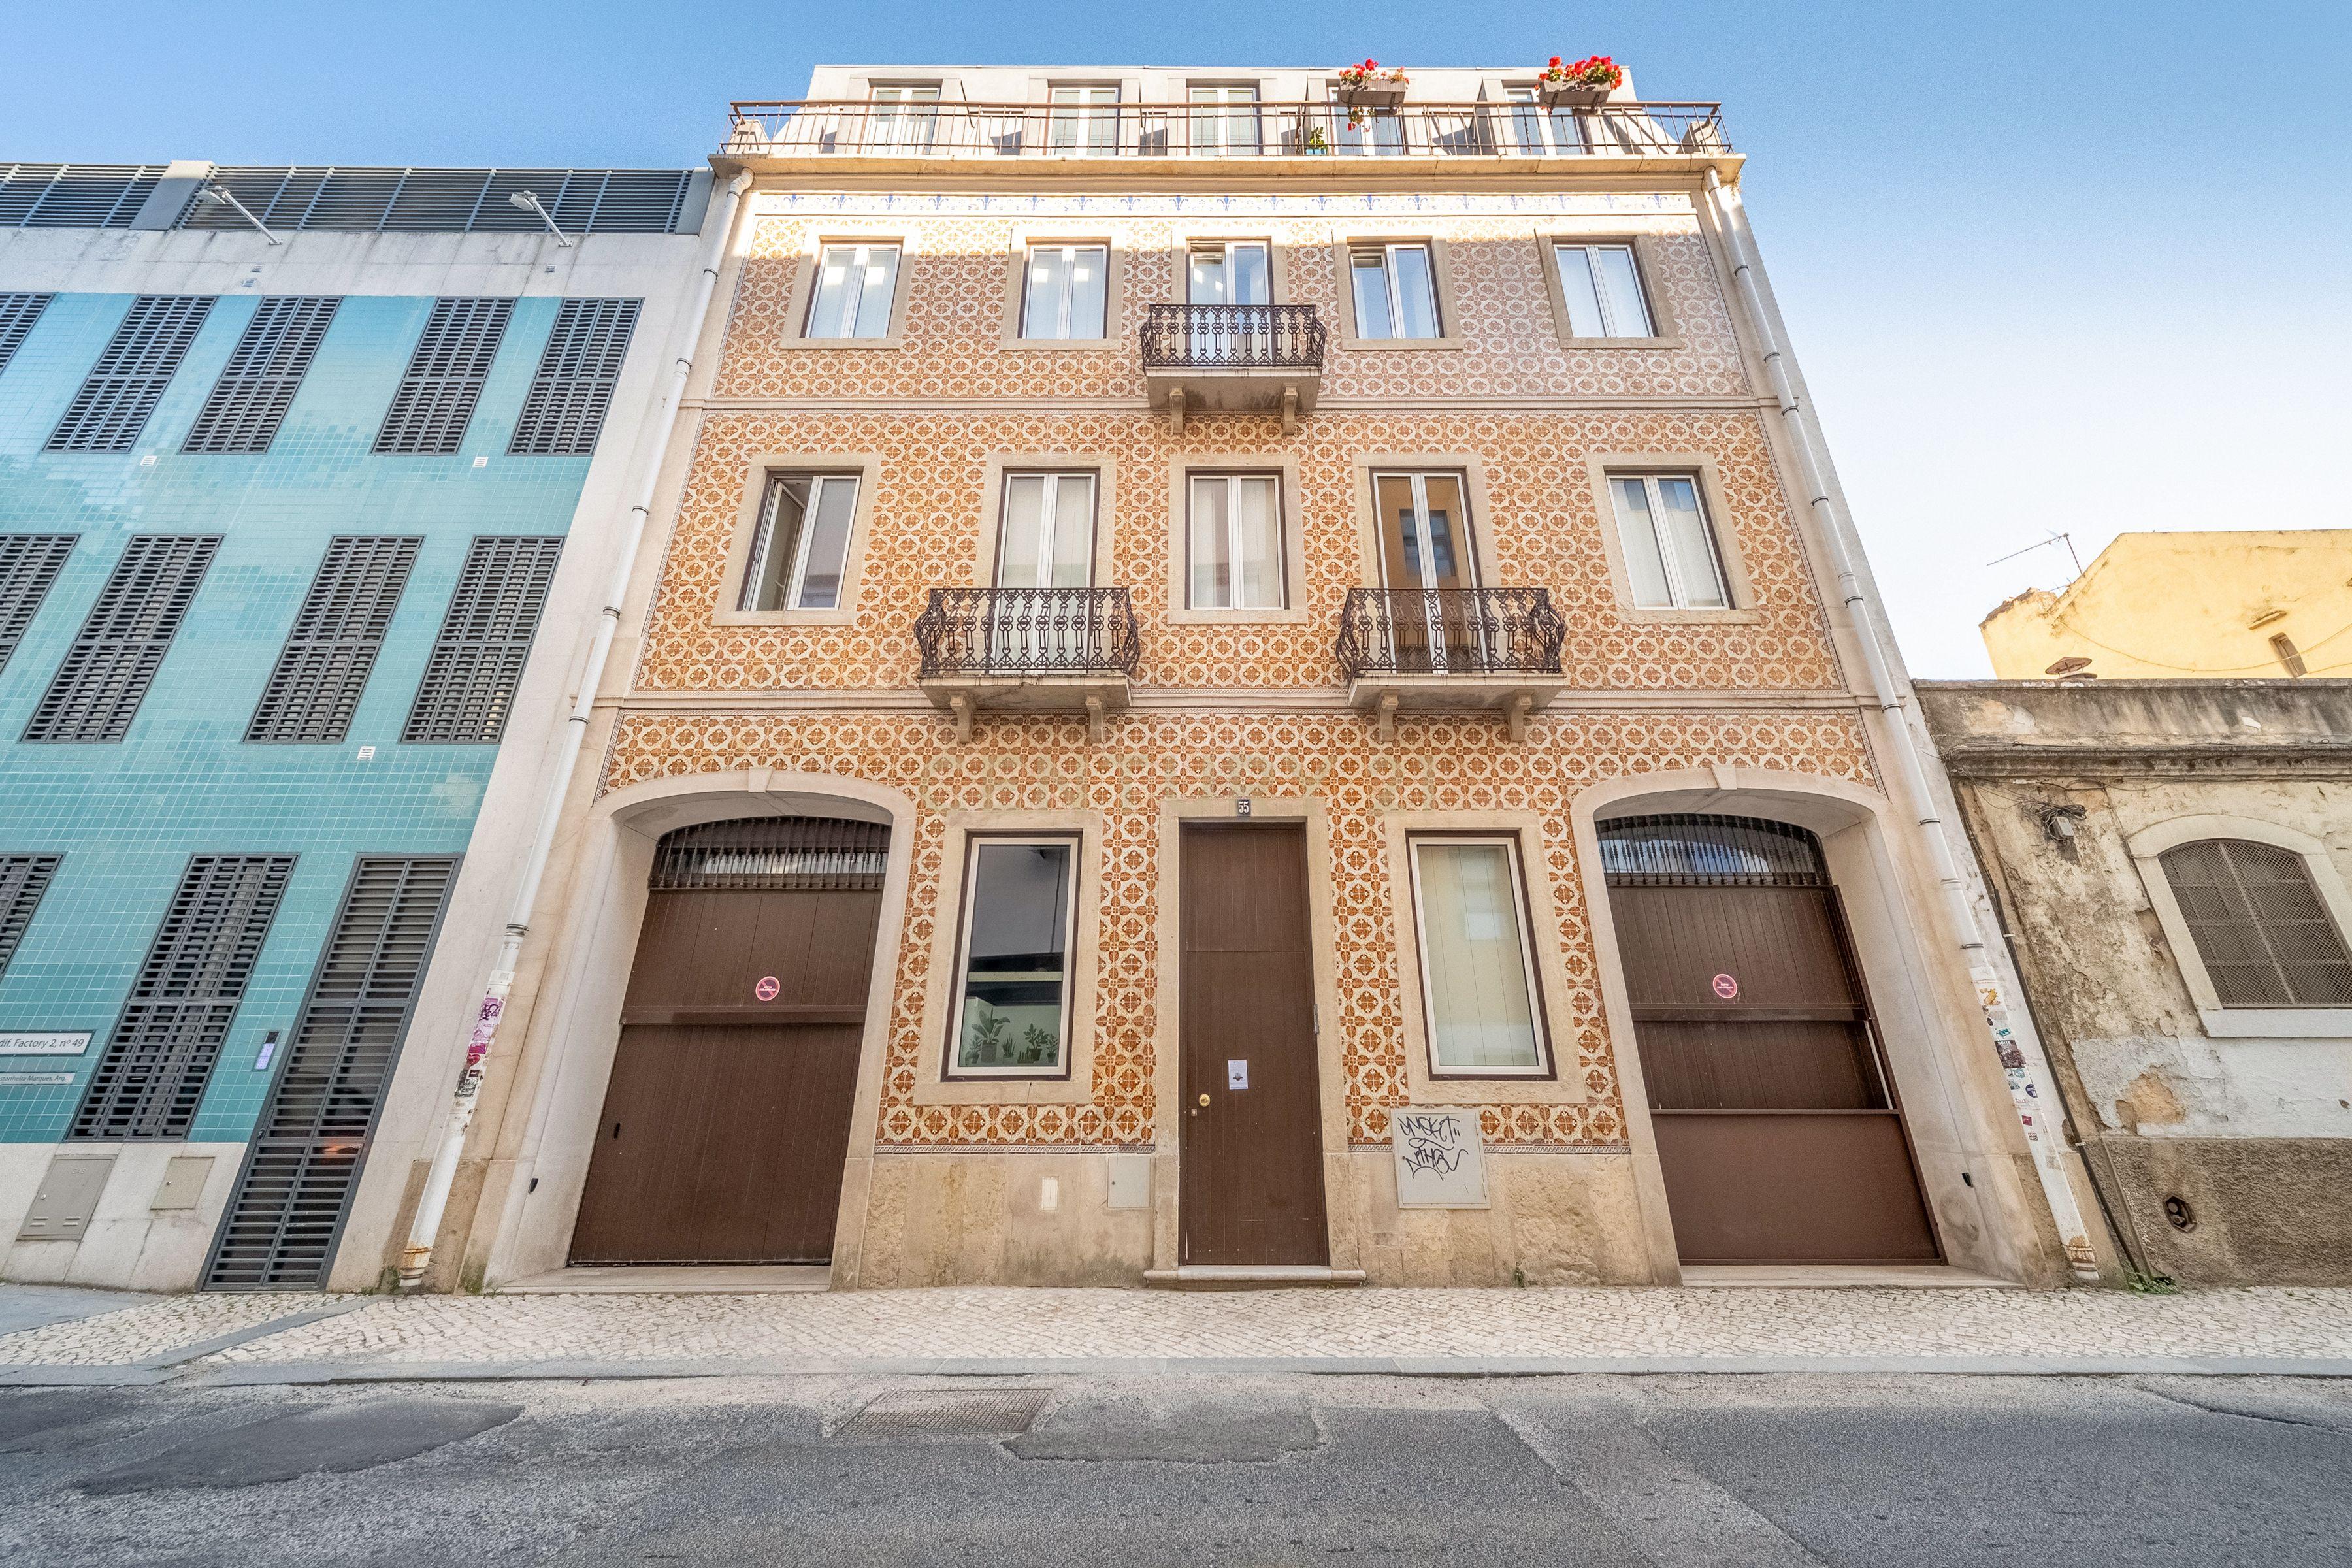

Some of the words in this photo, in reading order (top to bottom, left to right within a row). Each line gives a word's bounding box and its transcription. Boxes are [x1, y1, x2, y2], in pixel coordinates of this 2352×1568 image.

[1238, 801, 1249, 813] 55
[14, 1039, 49, 1049] Factory
[50, 1039, 57, 1048] 2,
